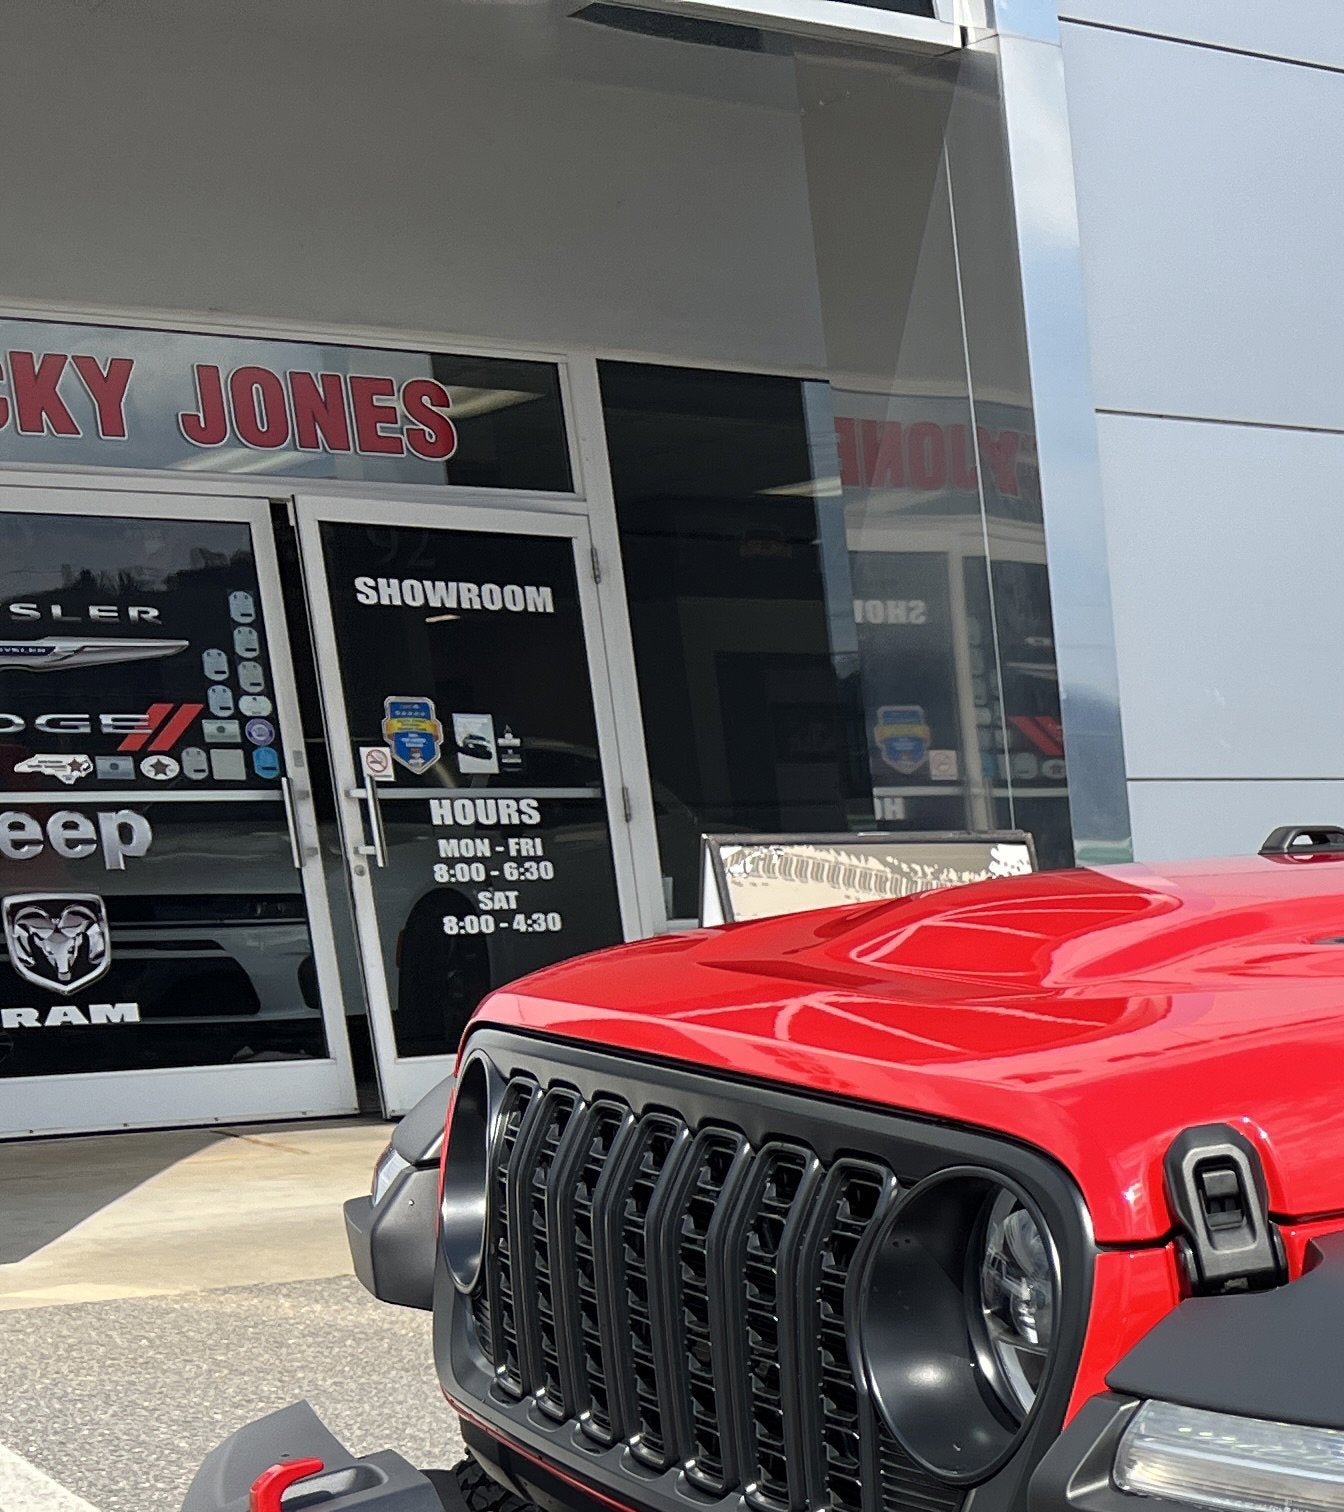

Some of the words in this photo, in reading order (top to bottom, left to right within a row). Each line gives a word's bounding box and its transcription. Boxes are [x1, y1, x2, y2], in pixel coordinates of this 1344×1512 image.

[0, 351, 134, 439] KY
[179, 363, 457, 461] JONES
[354, 576, 554, 613] SHOWROOM
[429, 798, 541, 826] HOURS
[437, 837, 492, 858] MON
[507, 837, 544, 857] FRI
[433, 862, 487, 883] 8:00
[503, 861, 554, 881] 6:30
[477, 891, 519, 910] SAT
[443, 915, 496, 935] 8:00
[512, 912, 562, 932] 4:30
[1, 1003, 141, 1028] RAM
